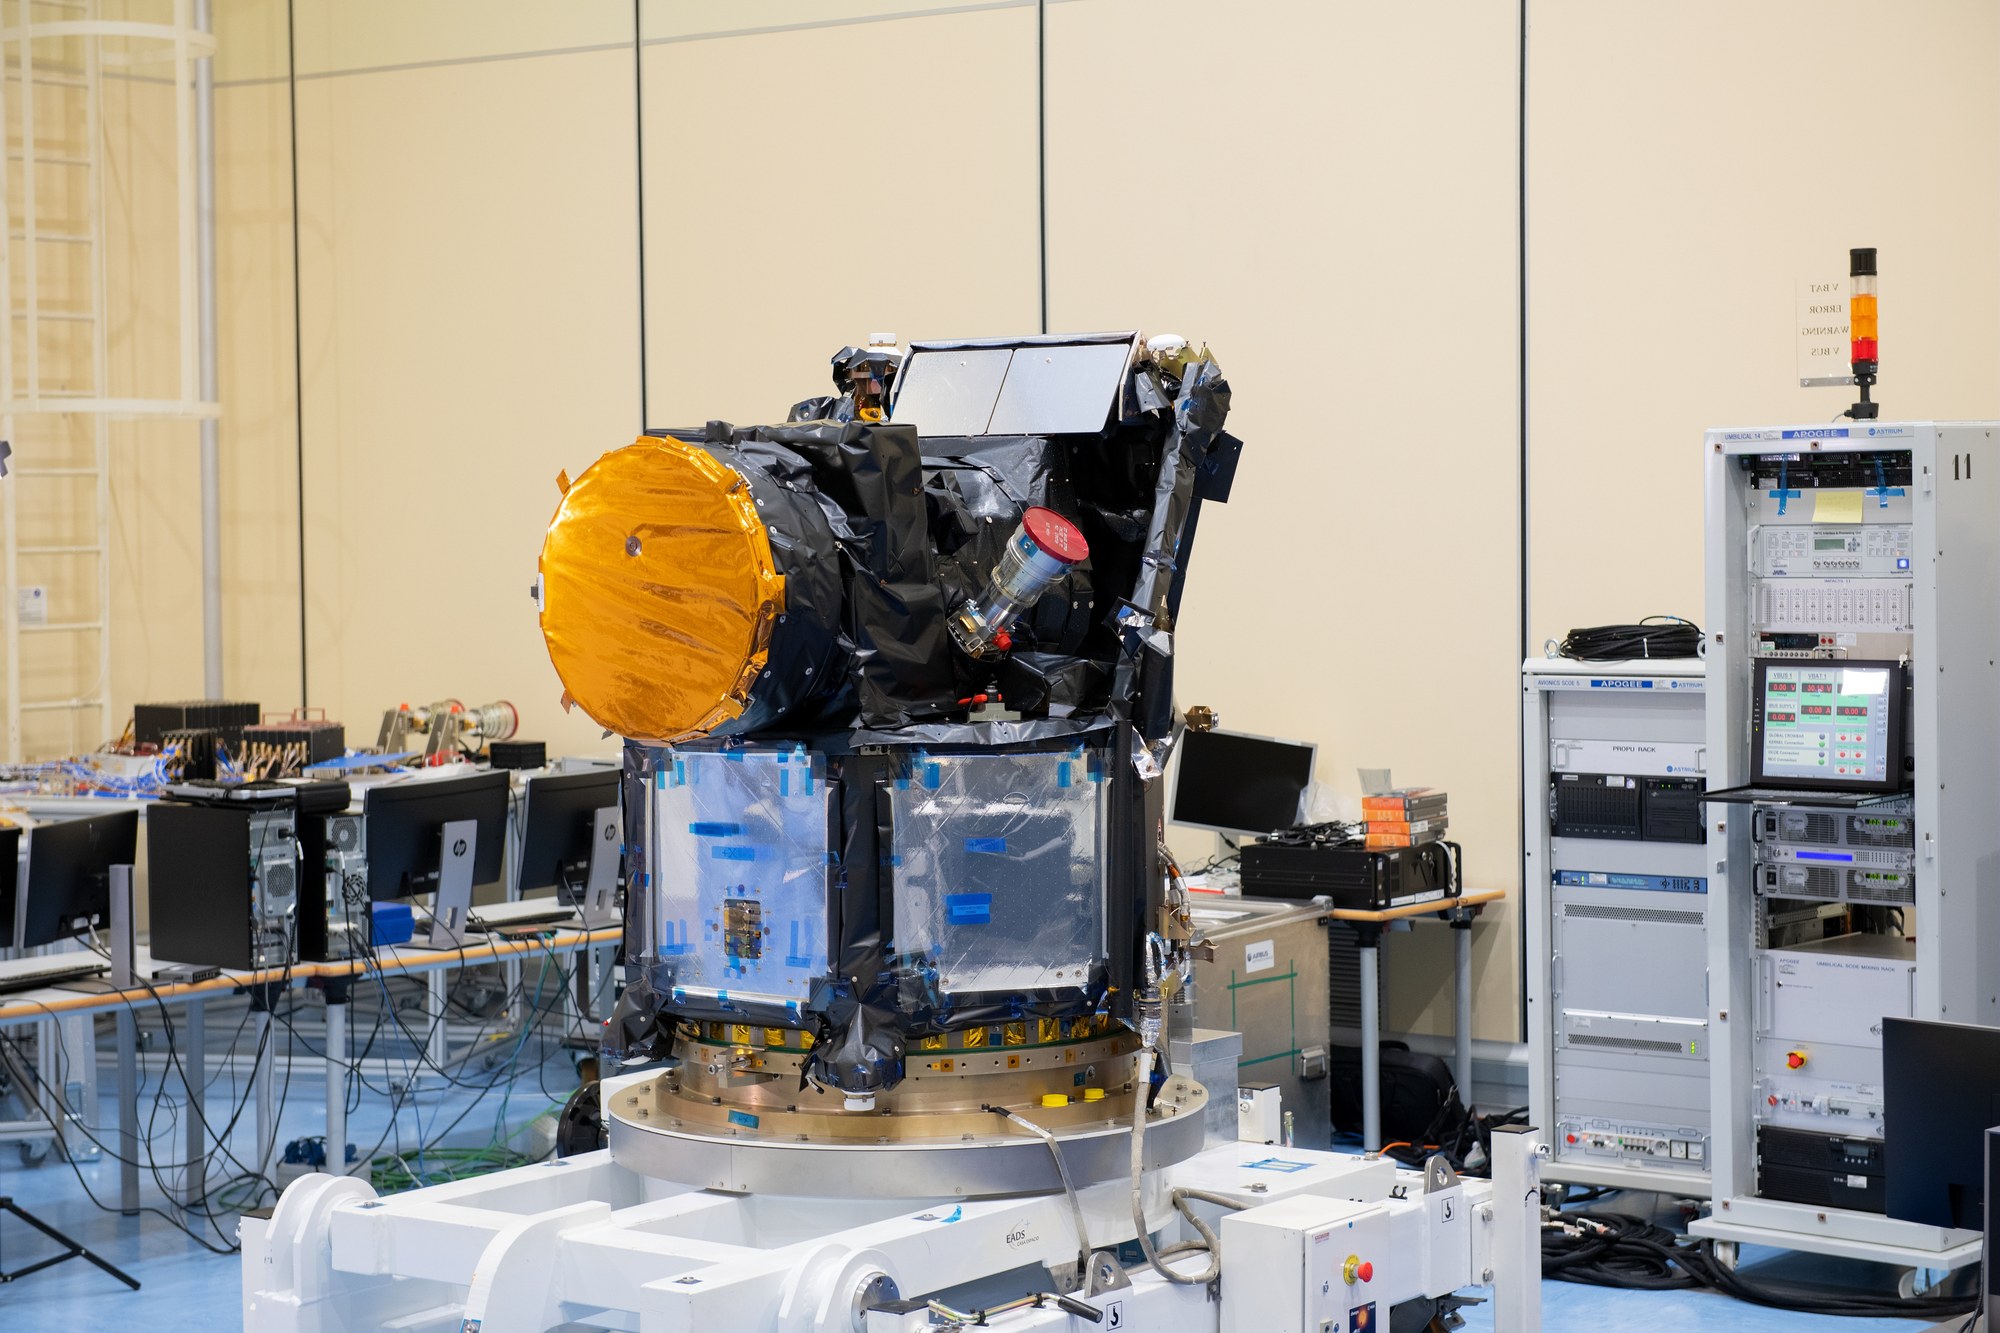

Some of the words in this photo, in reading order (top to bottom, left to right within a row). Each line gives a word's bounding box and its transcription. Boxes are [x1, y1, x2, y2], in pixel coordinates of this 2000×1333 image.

[1724, 432, 1753, 440] UMBILICAL
[1792, 429, 1838, 438] APOGEE
[1006, 1230, 1025, 1244] EADS
